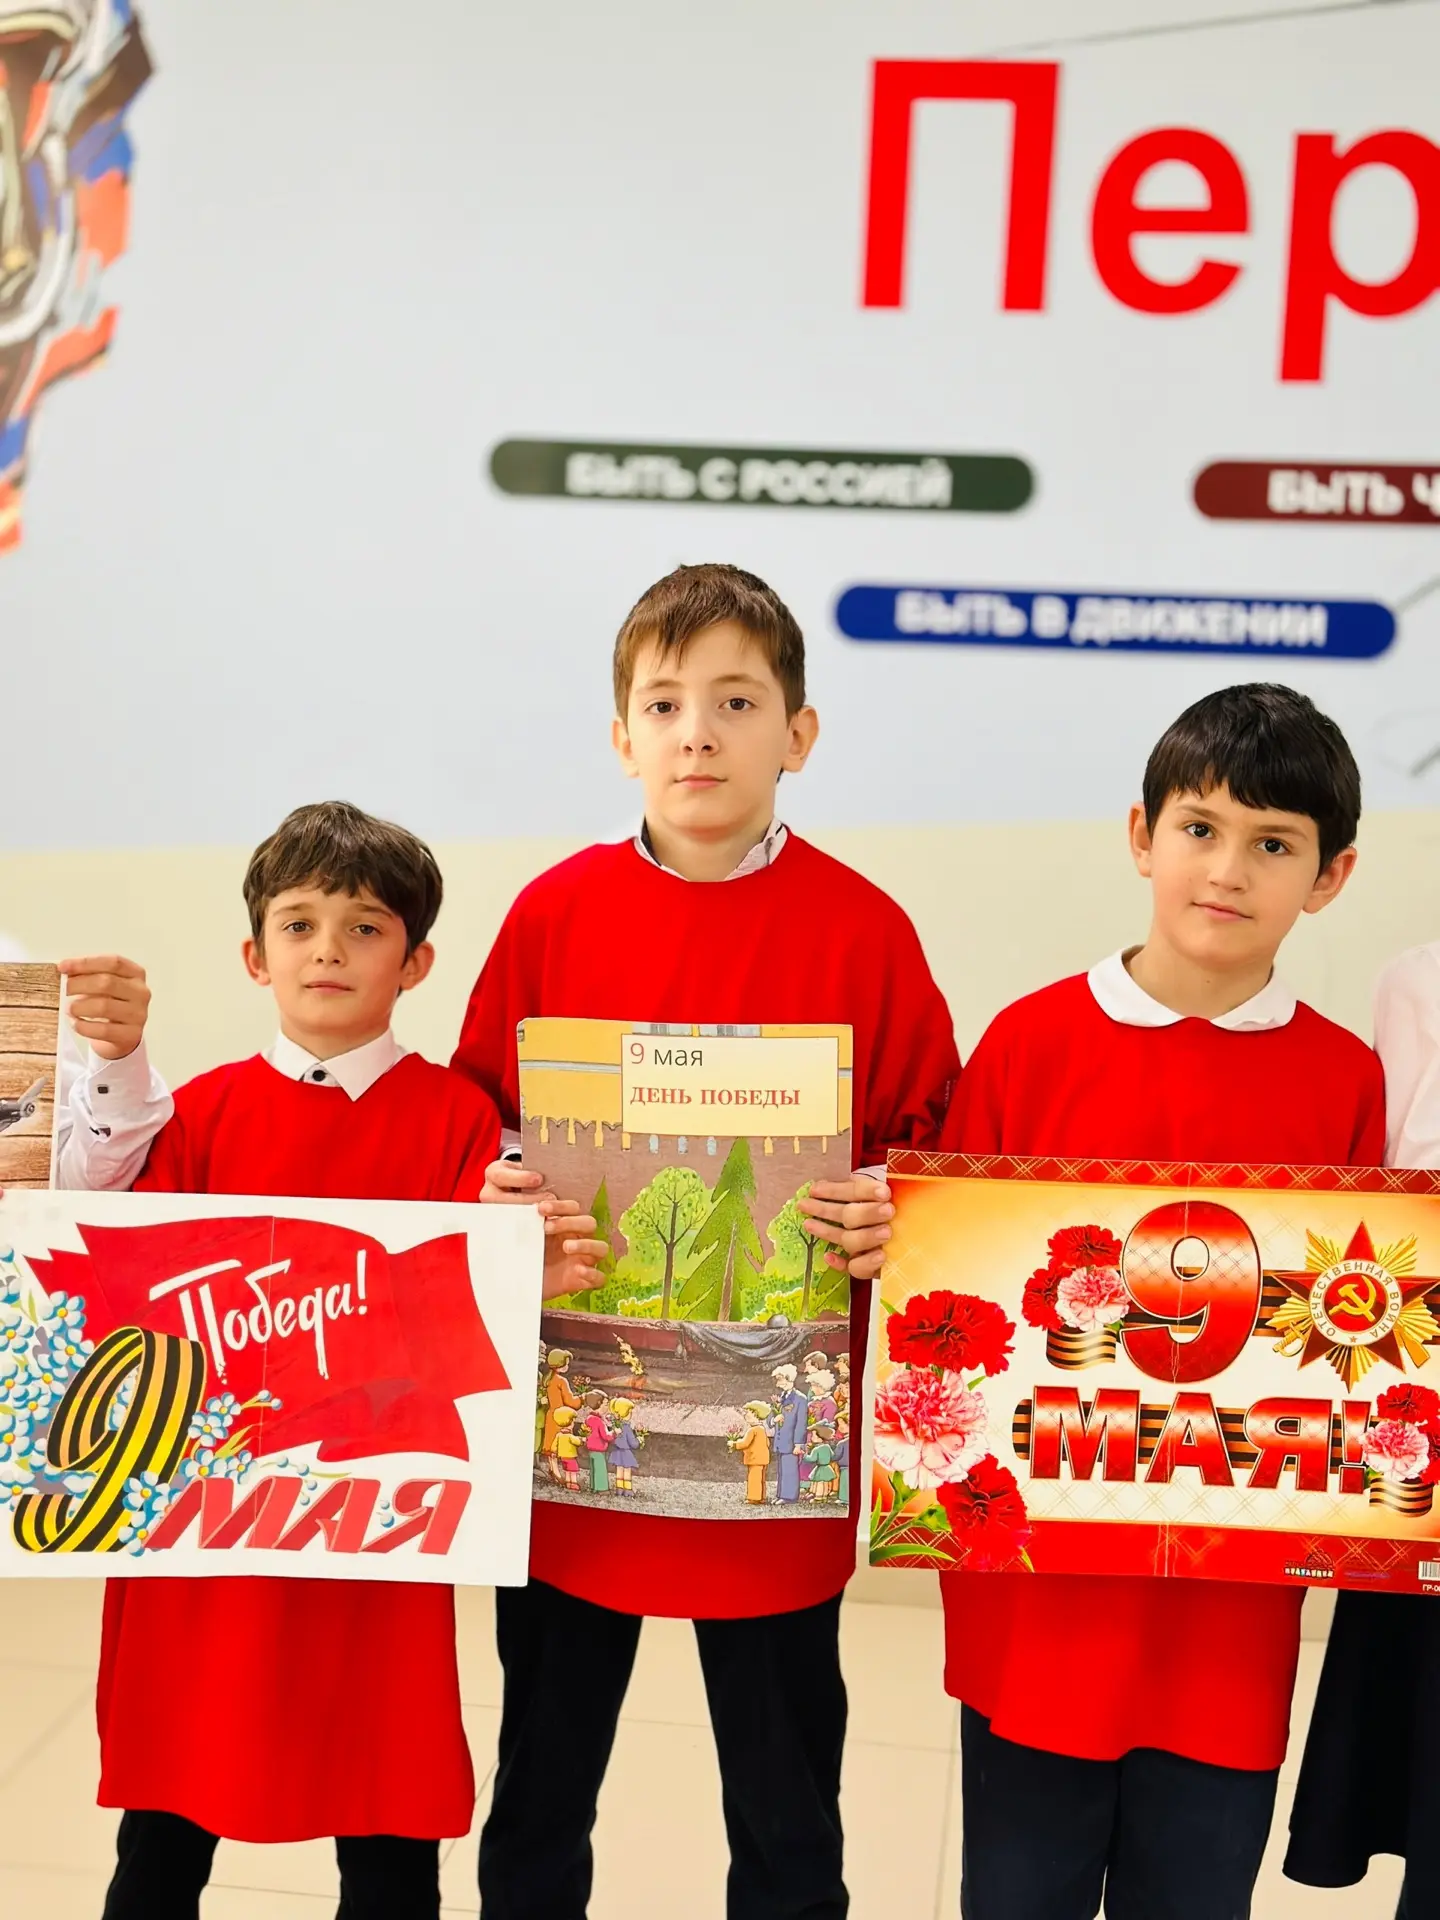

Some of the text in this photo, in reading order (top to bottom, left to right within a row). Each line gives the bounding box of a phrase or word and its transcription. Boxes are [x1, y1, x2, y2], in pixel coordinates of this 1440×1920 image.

[862, 58, 1440, 382] Пер
[566, 452, 952, 508] БЫТЬ С РОССИЕЙ
[1267, 469, 1405, 516] БЫТЬ
[895, 589, 1327, 647] БЫТЬ В ДВИЖЕНИИ
[630, 1043, 703, 1066] 9 мая
[630, 1087, 800, 1109] ДЕНЬ ПОБЕДЫ
[149, 1249, 367, 1384] Победа!
[1120, 1200, 1263, 1384] 9
[1312, 1261, 1394, 1338] ОТЕЧЕСТВЕННАЯ
[11, 1326, 472, 1556] 9 МАЯ
[1029, 1385, 1372, 1494] МАЯ!
